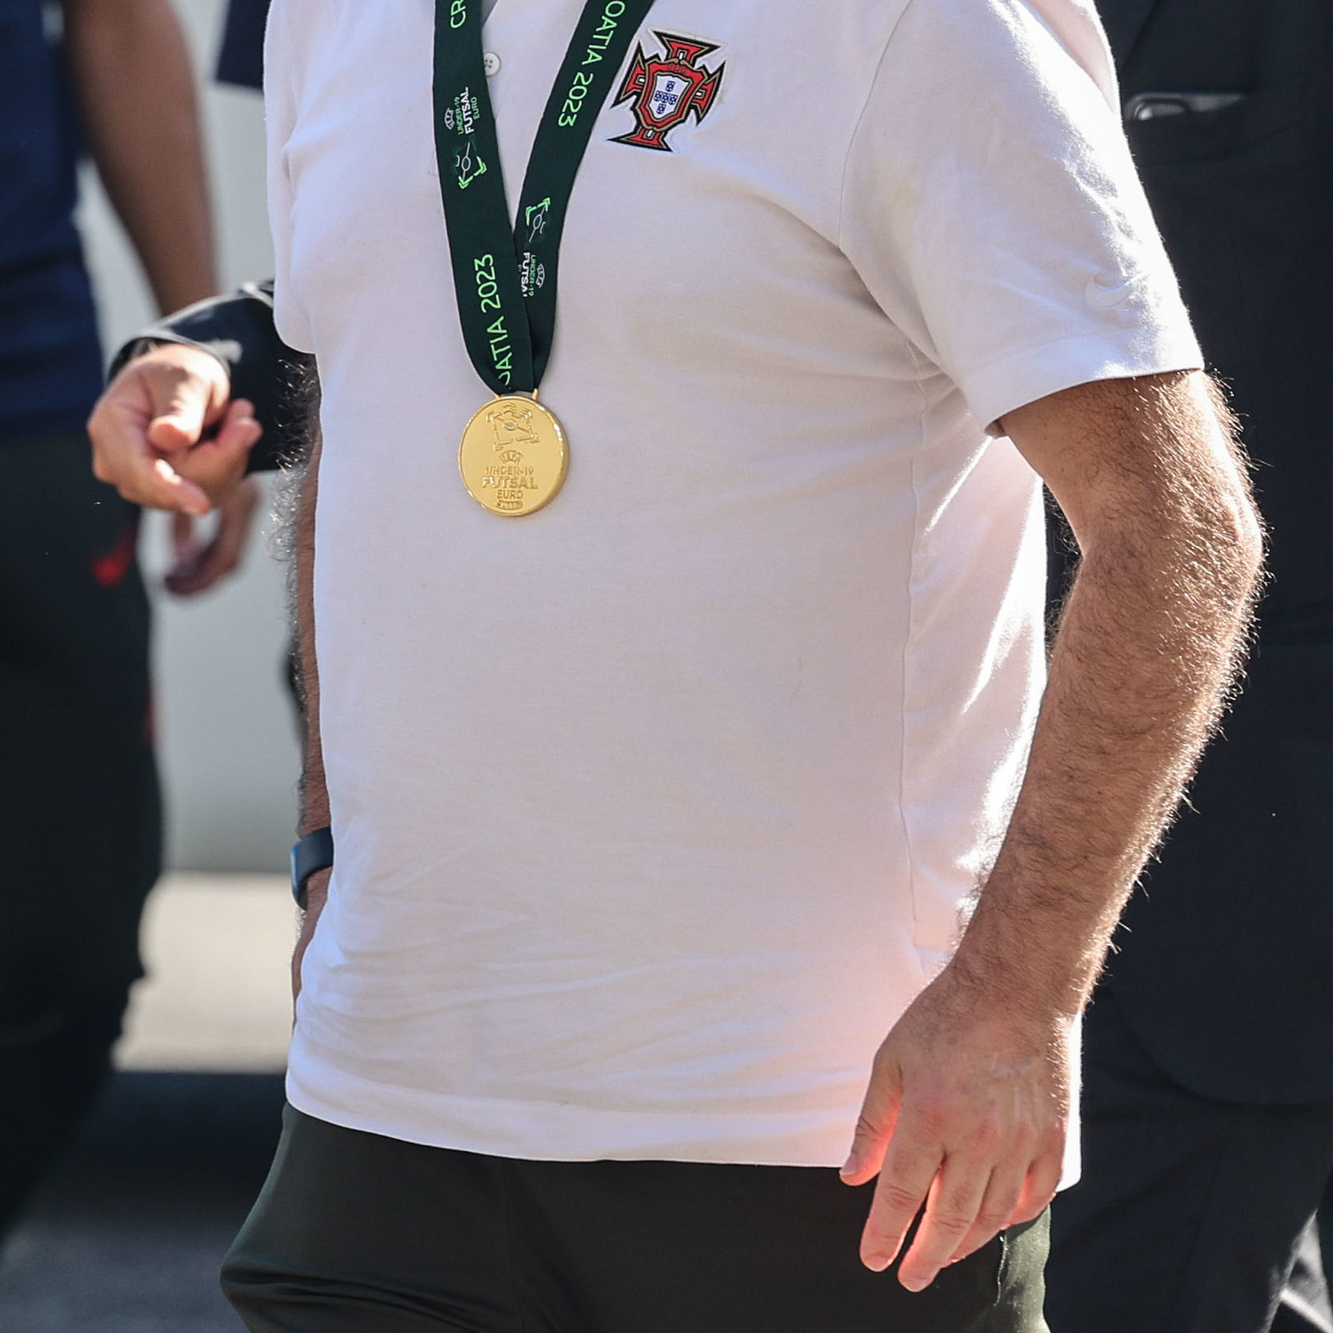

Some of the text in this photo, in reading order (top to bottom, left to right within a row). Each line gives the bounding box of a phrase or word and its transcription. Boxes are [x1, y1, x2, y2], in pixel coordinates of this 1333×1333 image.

[460, 87, 475, 134] FUTSAL
[471, 97, 480, 120] EURO
[558, 72, 594, 127] 2023
[474, 254, 501, 313] 2023
[482, 476, 539, 489] FUTSAL
[485, 466, 535, 476] UNDER-19
[496, 490, 524, 499] EURO
